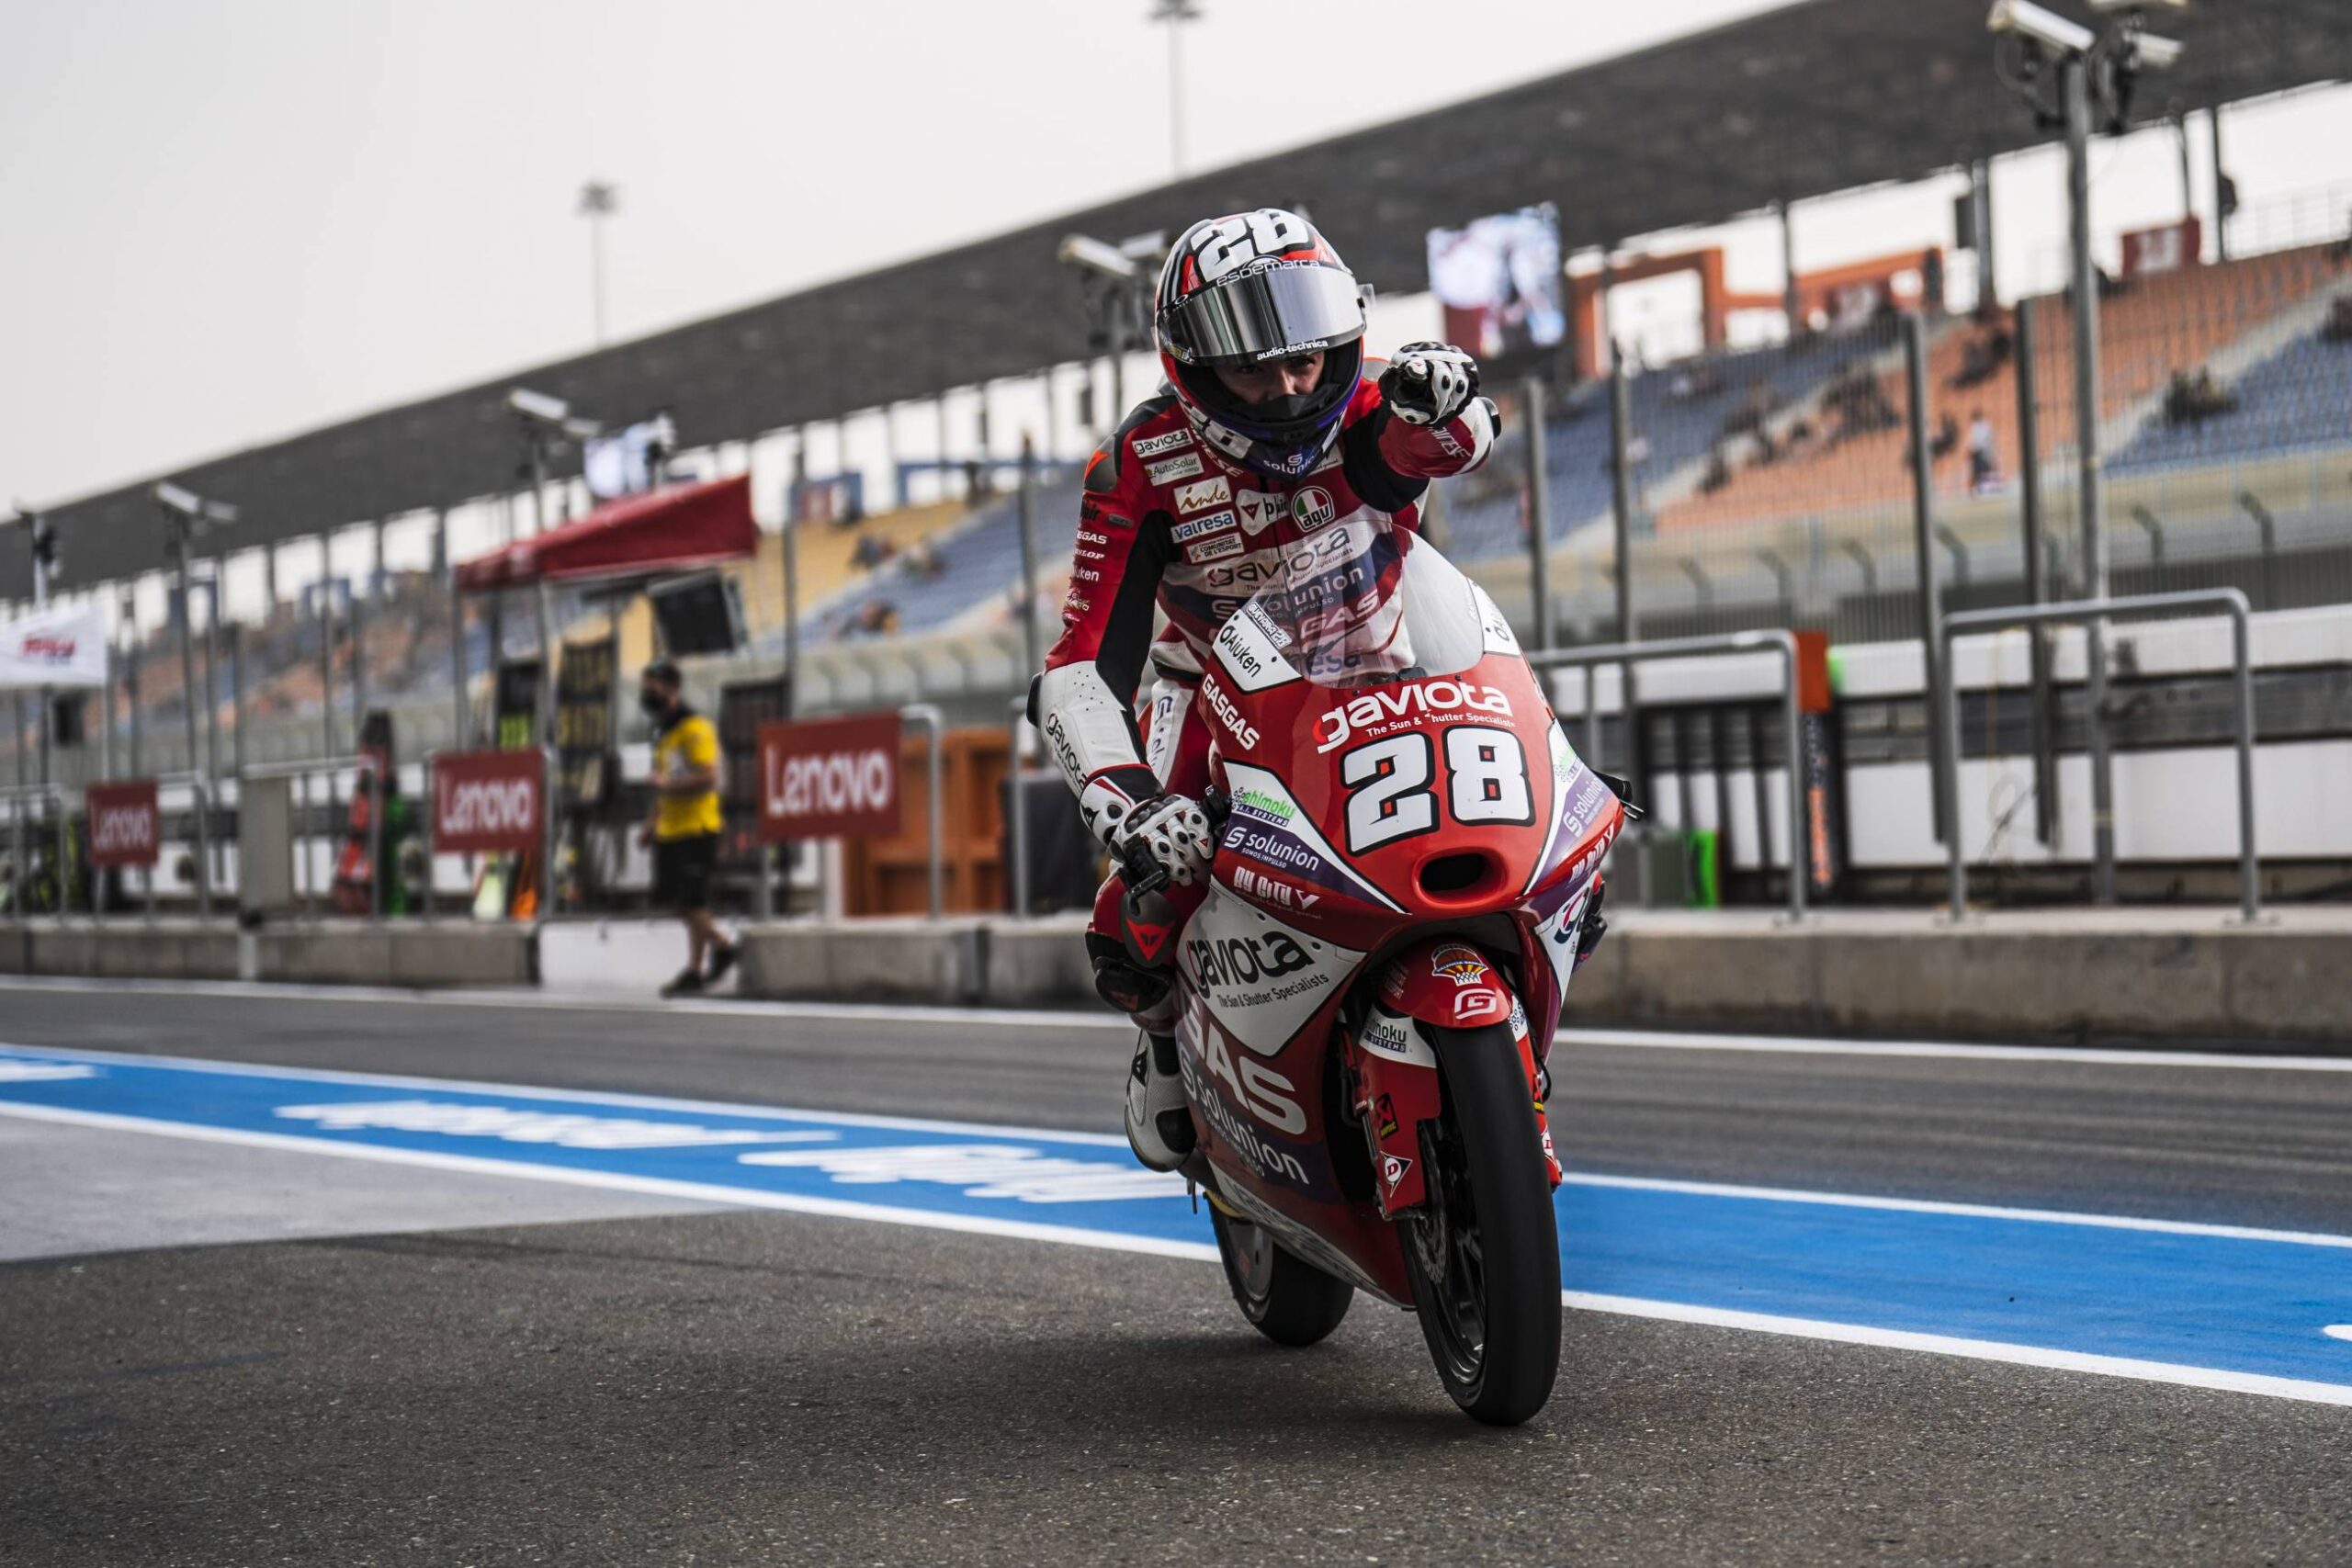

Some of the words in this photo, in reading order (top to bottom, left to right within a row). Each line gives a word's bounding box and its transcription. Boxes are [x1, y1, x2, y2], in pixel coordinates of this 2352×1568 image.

[1256, 340, 1329, 361] audio-technica
[1134, 430, 1190, 455] gaviota
[1153, 457, 1197, 476] AutoSolar
[1180, 484, 1229, 511] inde
[1303, 505, 1329, 527] agv
[1266, 566, 1364, 612] olunion
[1201, 672, 1261, 751] GASGAS
[1311, 681, 1514, 755] gaviota
[1365, 726, 1387, 738] The
[1391, 719, 1412, 731] Sun
[1413, 716, 1422, 726] &
[765, 745, 890, 816] Lenovo
[1340, 725, 1533, 855] 28
[440, 770, 532, 833] Lenovo
[1243, 790, 1295, 818] shimoku
[1251, 809, 1289, 827] SYSTEMS
[92, 802, 152, 851] Lenovo
[1246, 832, 1319, 872] solunion
[1186, 931, 1317, 999] gaviota
[1245, 991, 1272, 1007] Shutter
[1272, 973, 1330, 1002] Specialists
[1196, 1074, 1310, 1186] solunion
